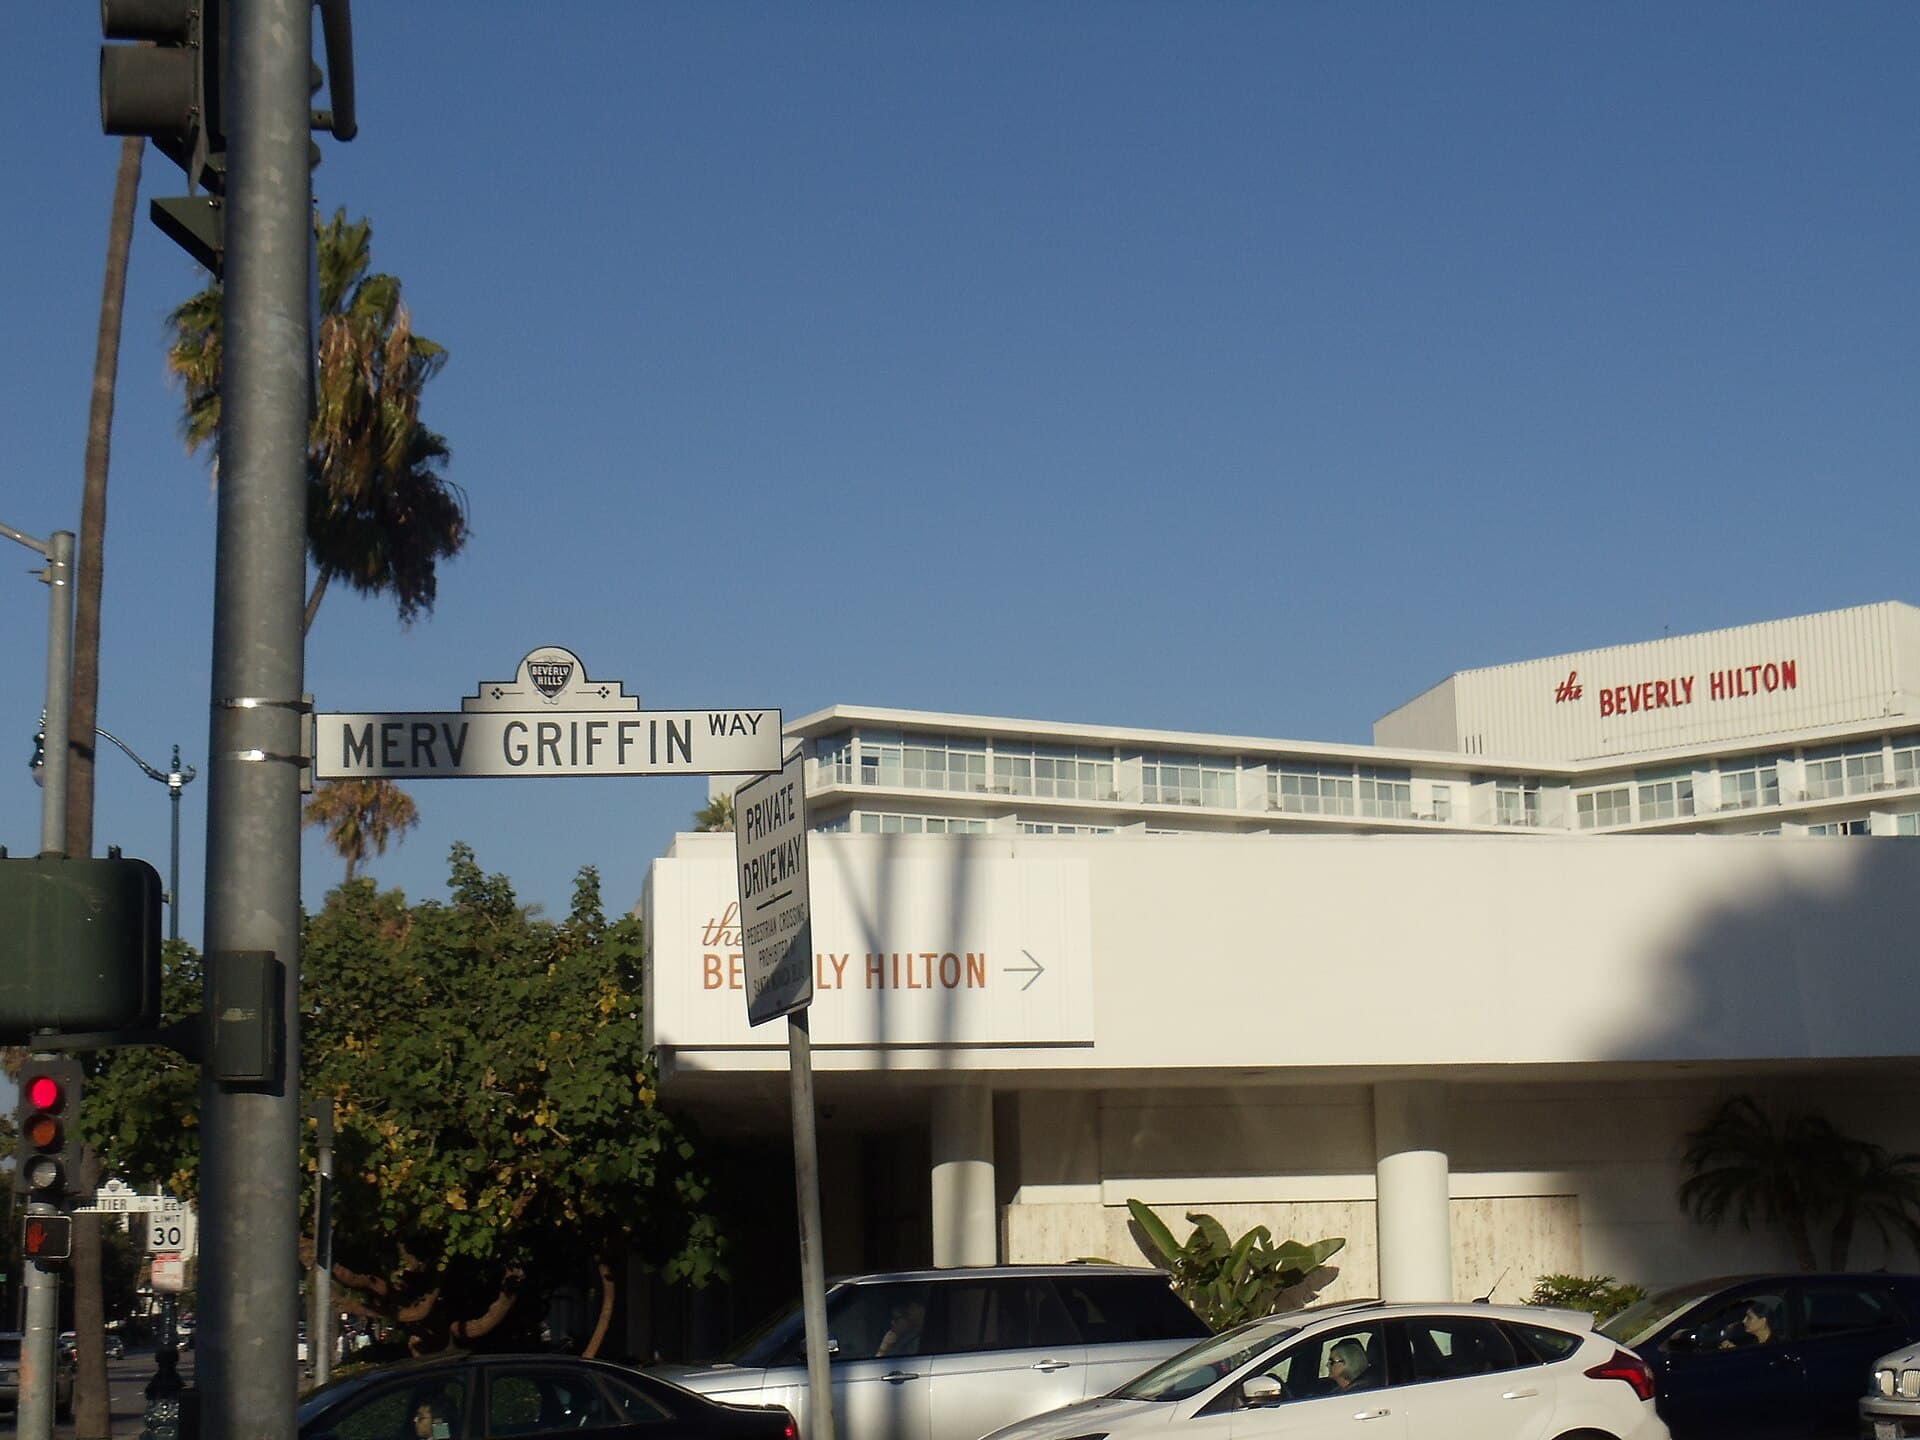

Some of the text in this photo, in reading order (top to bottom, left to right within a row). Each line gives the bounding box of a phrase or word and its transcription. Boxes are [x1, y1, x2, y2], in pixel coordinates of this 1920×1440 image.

[532, 665, 569, 676] BEVERLY
[537, 676, 563, 686] HILLS
[1554, 671, 1583, 703] the
[1599, 659, 1797, 717] BEVERLY HILTON
[342, 713, 763, 768] MERV GRIFFIN WAY
[746, 782, 795, 844] PRIVATE
[743, 834, 801, 899] DRIVEWAY
[702, 901, 743, 947] the
[703, 953, 850, 990] BELY
[865, 952, 986, 990] HILTON
[153, 1215, 181, 1223] LIMIT
[153, 1227, 181, 1246] 30
